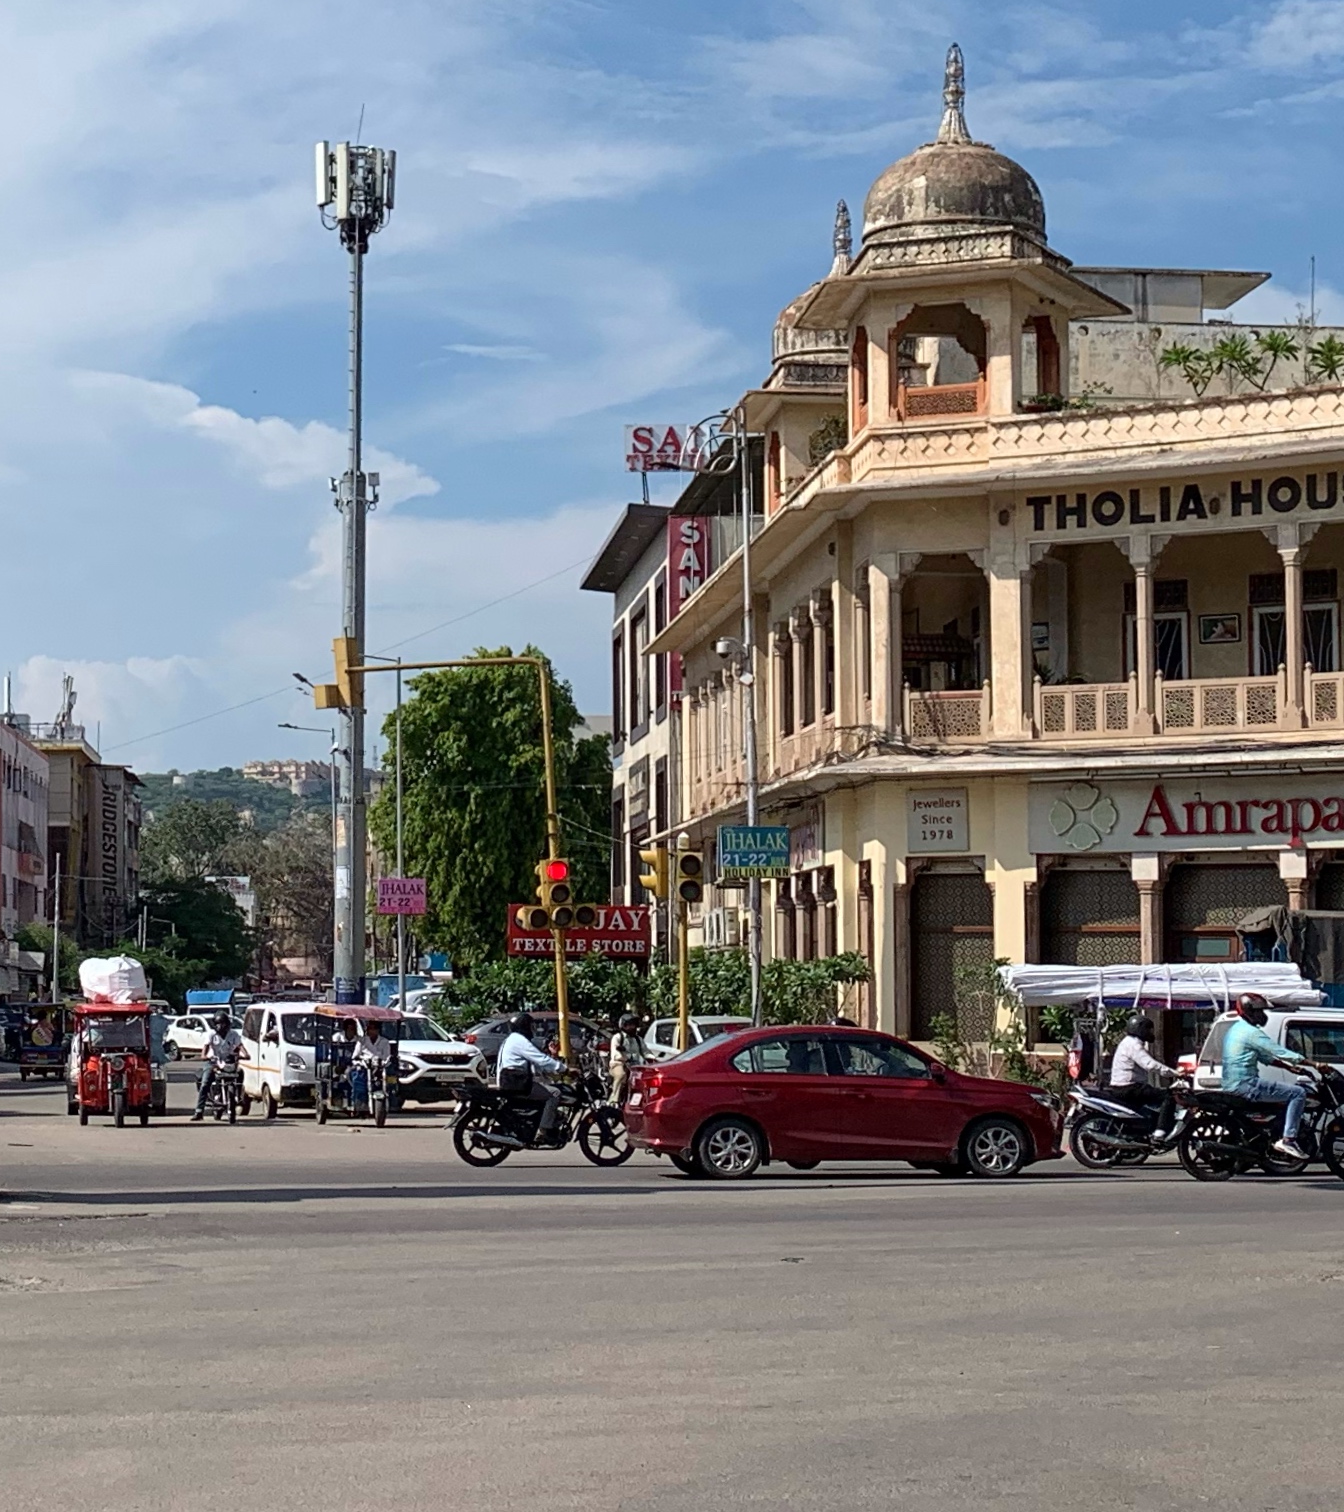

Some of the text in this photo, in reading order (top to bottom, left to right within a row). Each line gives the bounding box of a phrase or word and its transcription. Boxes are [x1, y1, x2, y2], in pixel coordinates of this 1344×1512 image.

[1026, 483, 1208, 531] THOLIA
[913, 797, 961, 812] Jewellers
[921, 814, 953, 825] Since
[724, 832, 787, 851] JHALAK
[922, 829, 954, 841] 1978
[725, 868, 789, 877] HOLIDAY INN
[380, 883, 424, 896] JHALAK
[512, 938, 645, 953] TEXTLE STORE
